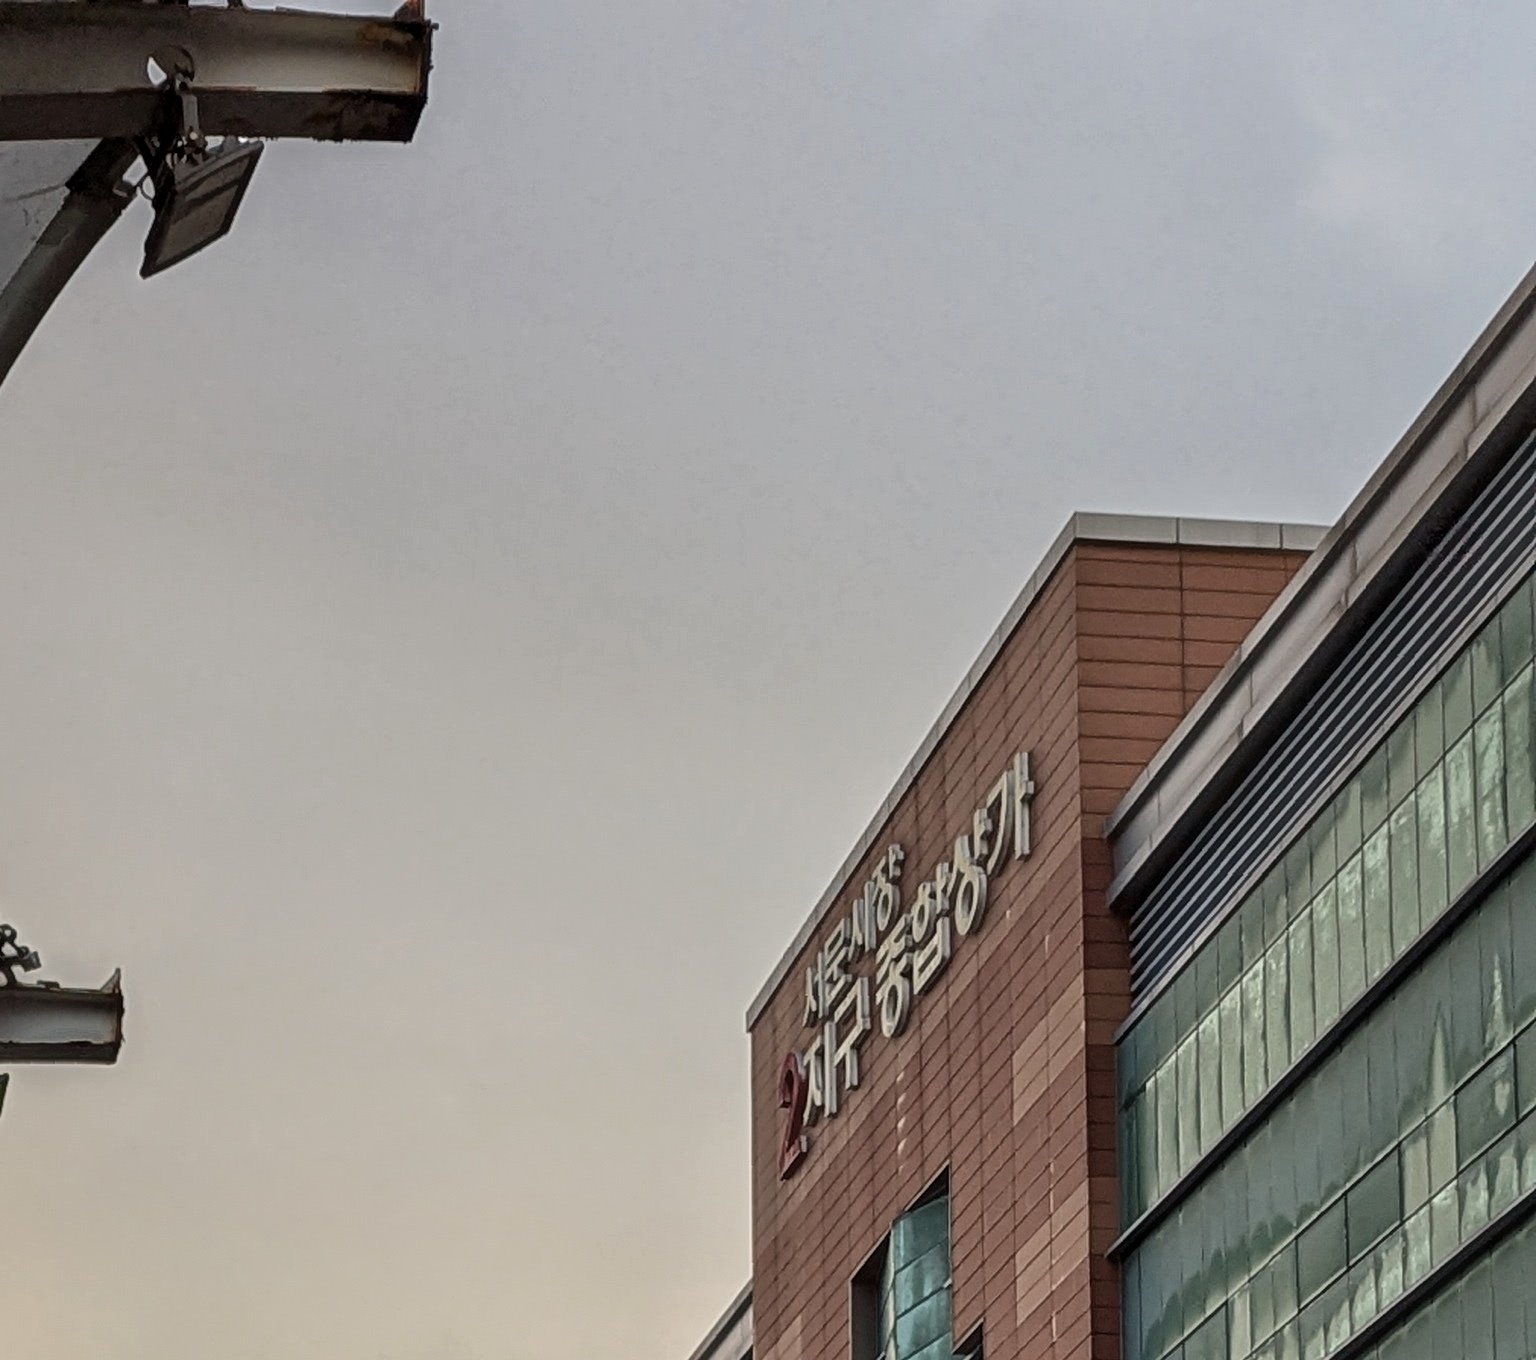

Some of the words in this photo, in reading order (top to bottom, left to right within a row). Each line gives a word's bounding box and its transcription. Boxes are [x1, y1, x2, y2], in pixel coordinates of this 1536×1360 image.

[778, 976, 871, 1180] 2지구
[876, 751, 1035, 1039] 종합상가
[802, 843, 904, 1028] 서문시장
